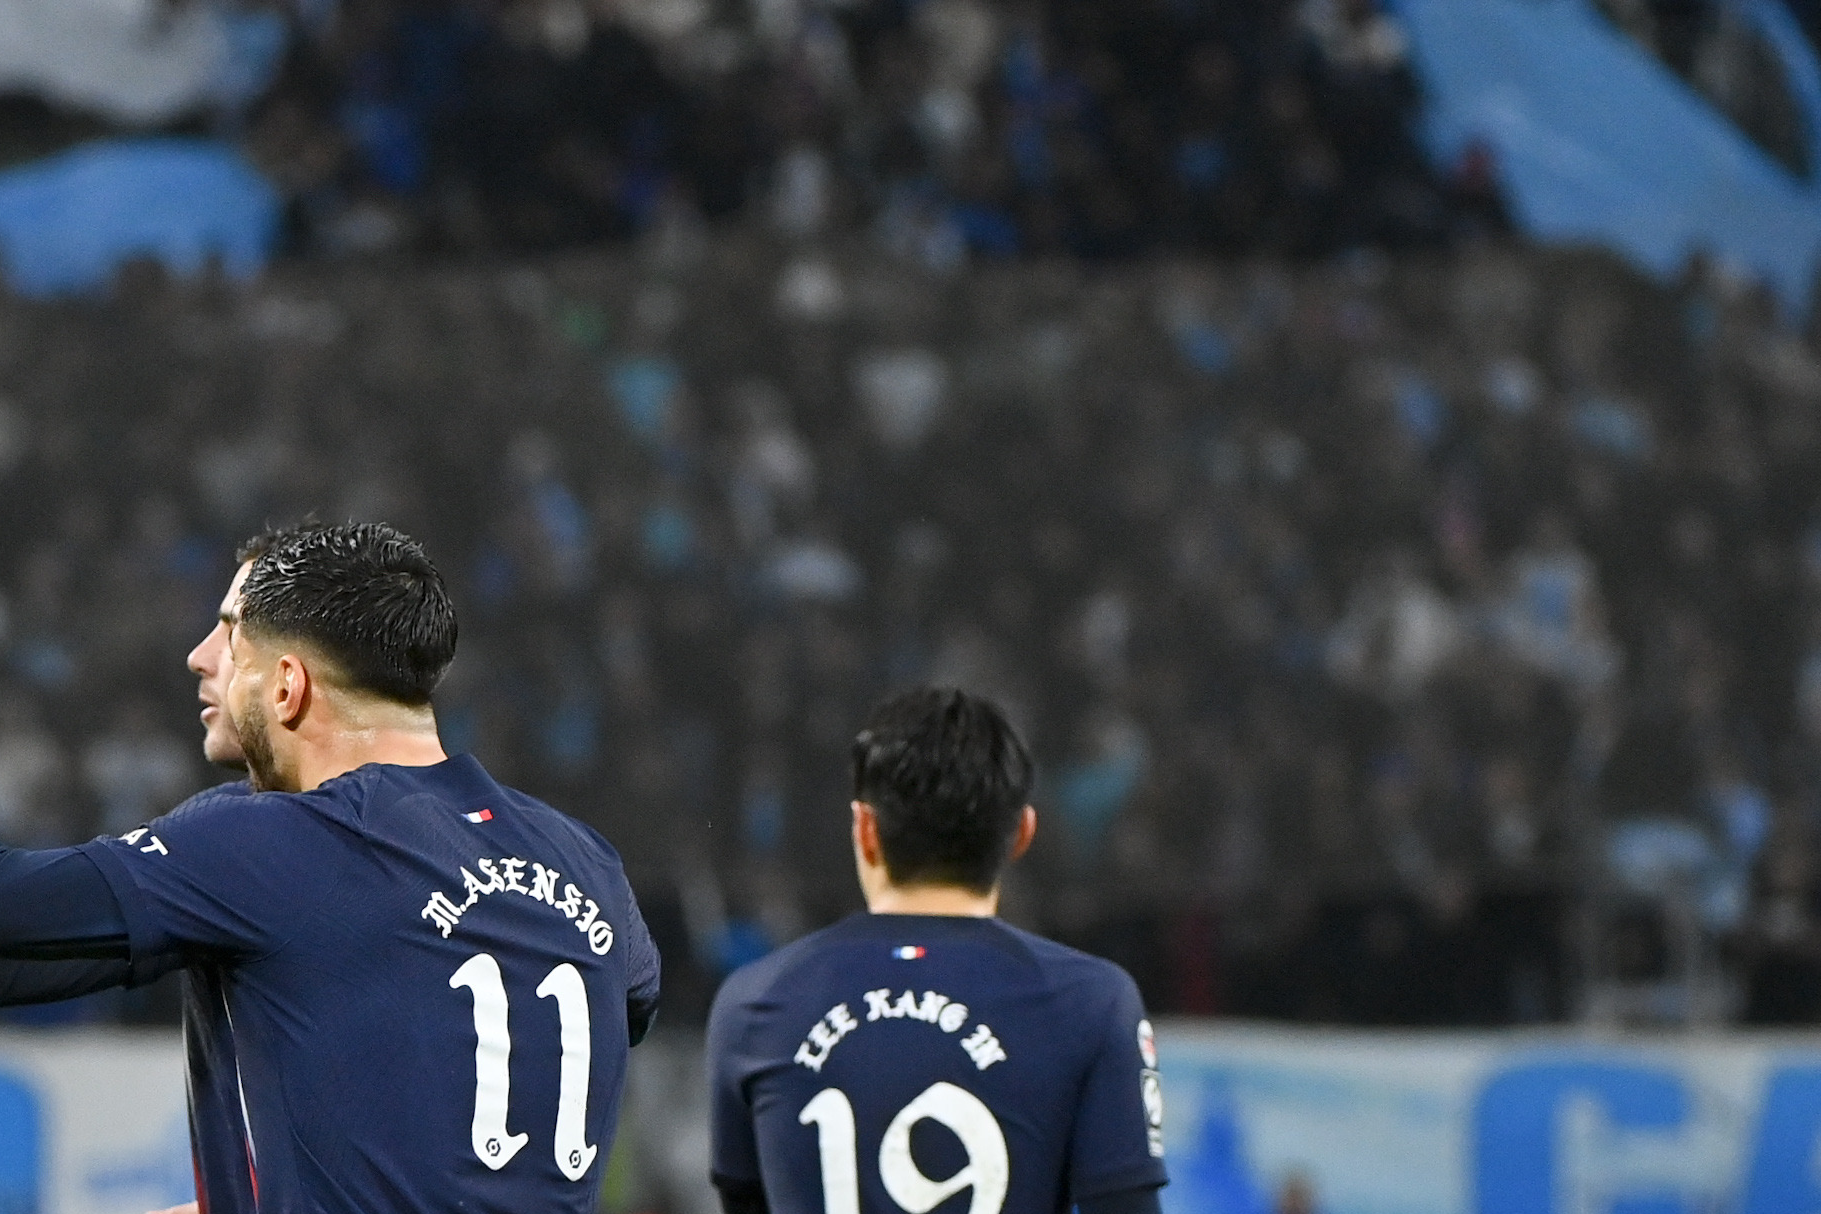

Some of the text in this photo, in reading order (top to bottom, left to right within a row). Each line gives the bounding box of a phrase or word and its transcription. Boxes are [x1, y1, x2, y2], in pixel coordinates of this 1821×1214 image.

[449, 953, 598, 1182] 11
[794, 1002, 859, 1073] LEE
[862, 987, 969, 1033] KANG
